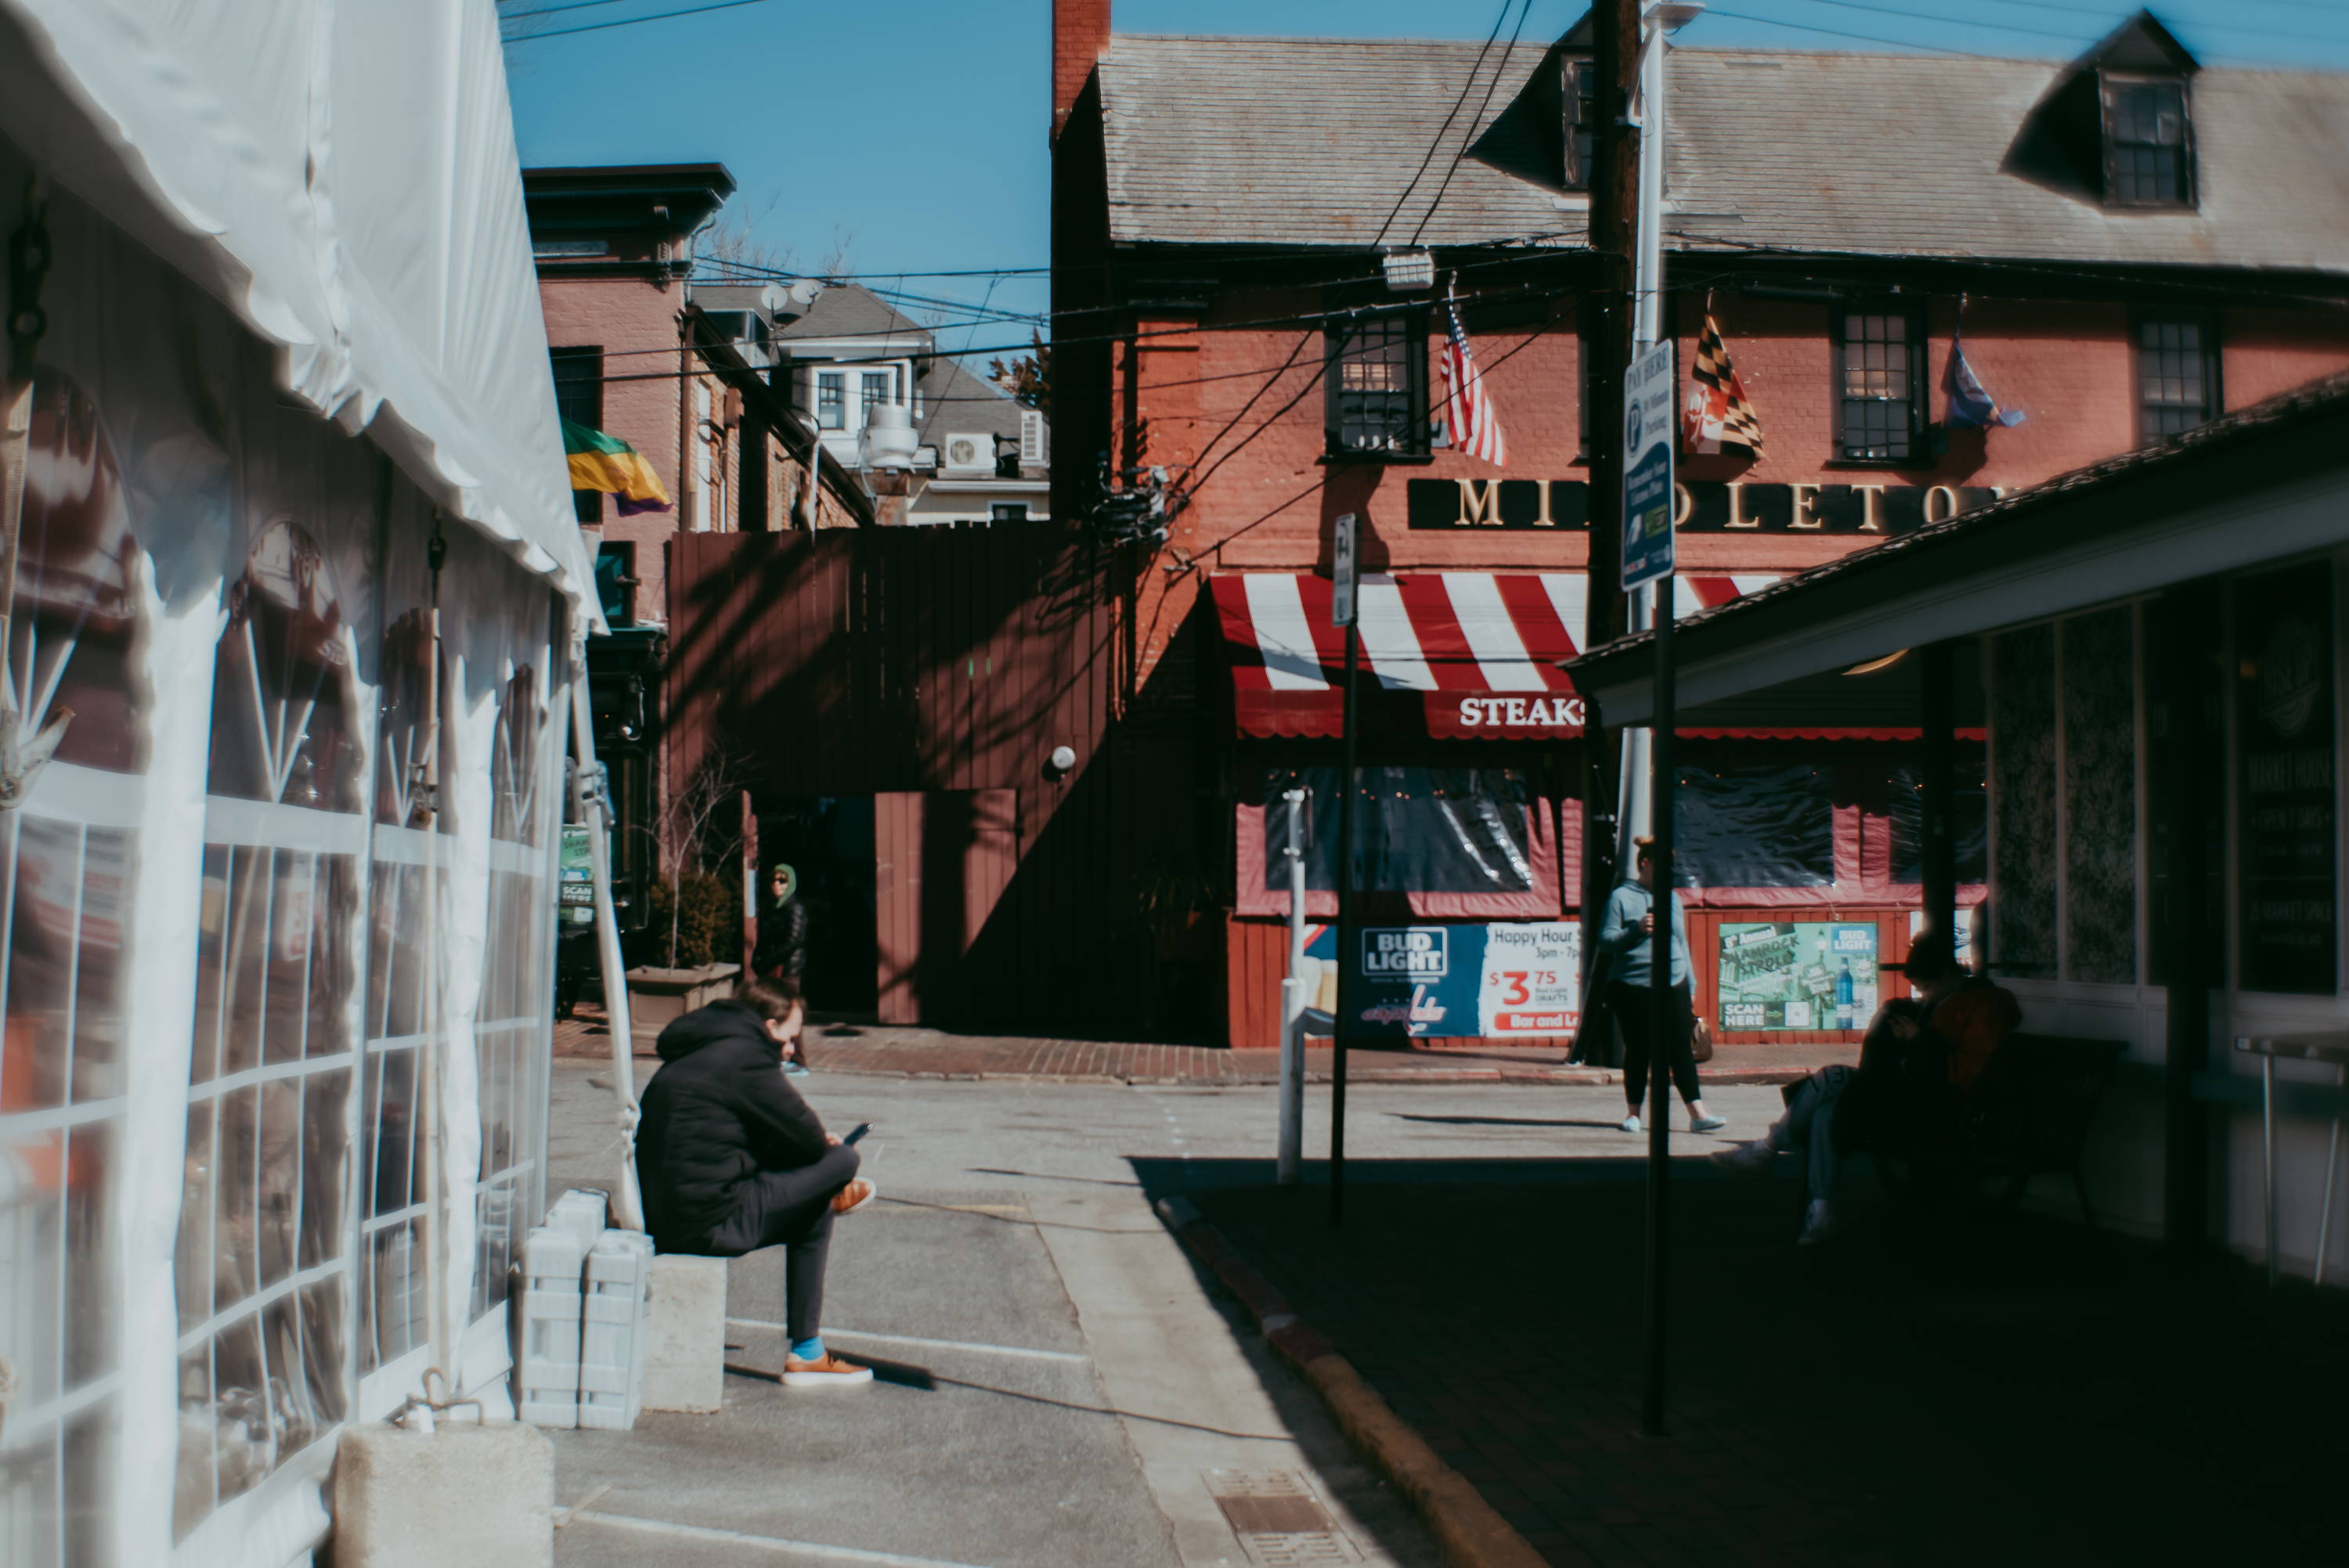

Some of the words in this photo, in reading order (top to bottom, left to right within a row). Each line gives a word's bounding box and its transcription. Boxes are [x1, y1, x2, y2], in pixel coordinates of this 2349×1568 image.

[1627, 366, 1641, 394] PAY
[1644, 348, 1667, 383] HERE
[1454, 478, 2022, 530] MILETO
[1460, 698, 1586, 726] STEAK
[1378, 932, 1432, 951] BUD
[1495, 928, 1537, 946] Happy
[1541, 928, 1573, 943] Hour
[1839, 929, 1867, 939] BUD
[1835, 939, 1871, 950] LIGHT
[1368, 950, 1442, 971] LIGHT
[1535, 947, 1557, 960] 3pm
[1567, 946, 1579, 959] 7p
[1725, 1004, 1764, 1015] SCAN
[1510, 1015, 1535, 1028] Bar
[1536, 1015, 1564, 1028] and
[1725, 1015, 1764, 1027] HERE
